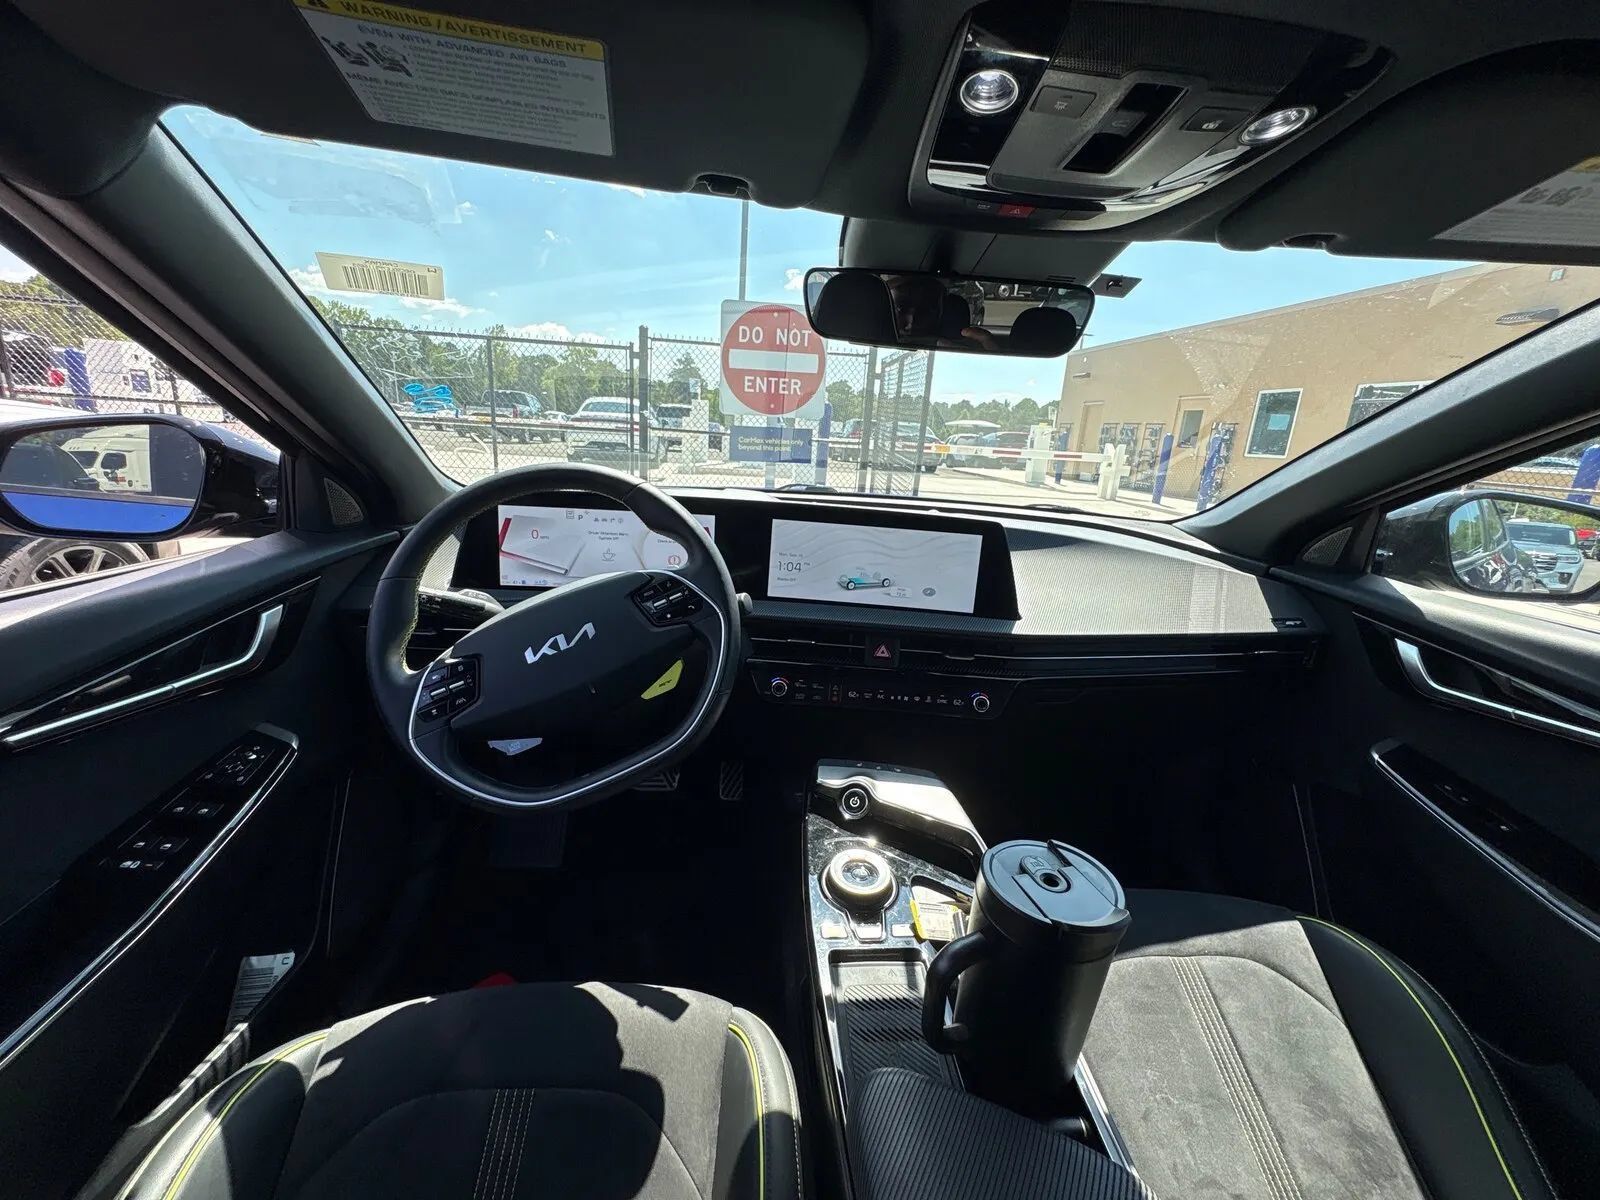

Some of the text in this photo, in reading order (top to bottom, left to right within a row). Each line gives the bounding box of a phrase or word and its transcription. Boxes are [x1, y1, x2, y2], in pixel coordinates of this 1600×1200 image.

[341, 0, 432, 26] WARNING
[446, 21, 586, 53] AVERTISSEMENT
[358, 24, 394, 39] EVEN
[738, 325, 811, 347] DO NOT
[744, 376, 802, 395] ENTER
[531, 529, 539, 540] 0
[778, 561, 801, 573] 1:04
